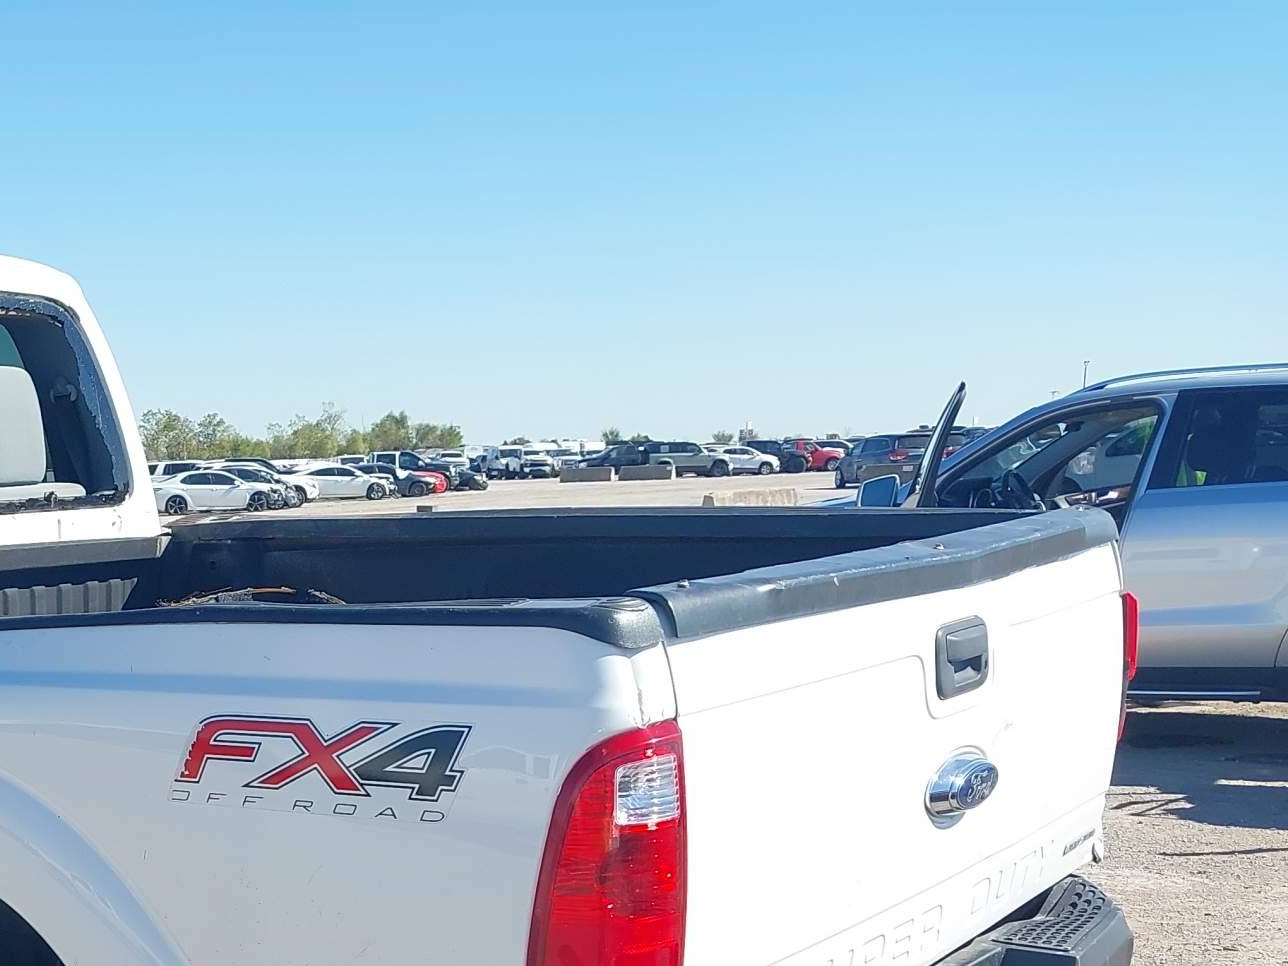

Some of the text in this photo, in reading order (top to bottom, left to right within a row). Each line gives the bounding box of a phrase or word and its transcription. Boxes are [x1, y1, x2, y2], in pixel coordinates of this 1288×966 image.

[174, 713, 473, 802] FX4
[171, 788, 445, 823] OFF ROAD
